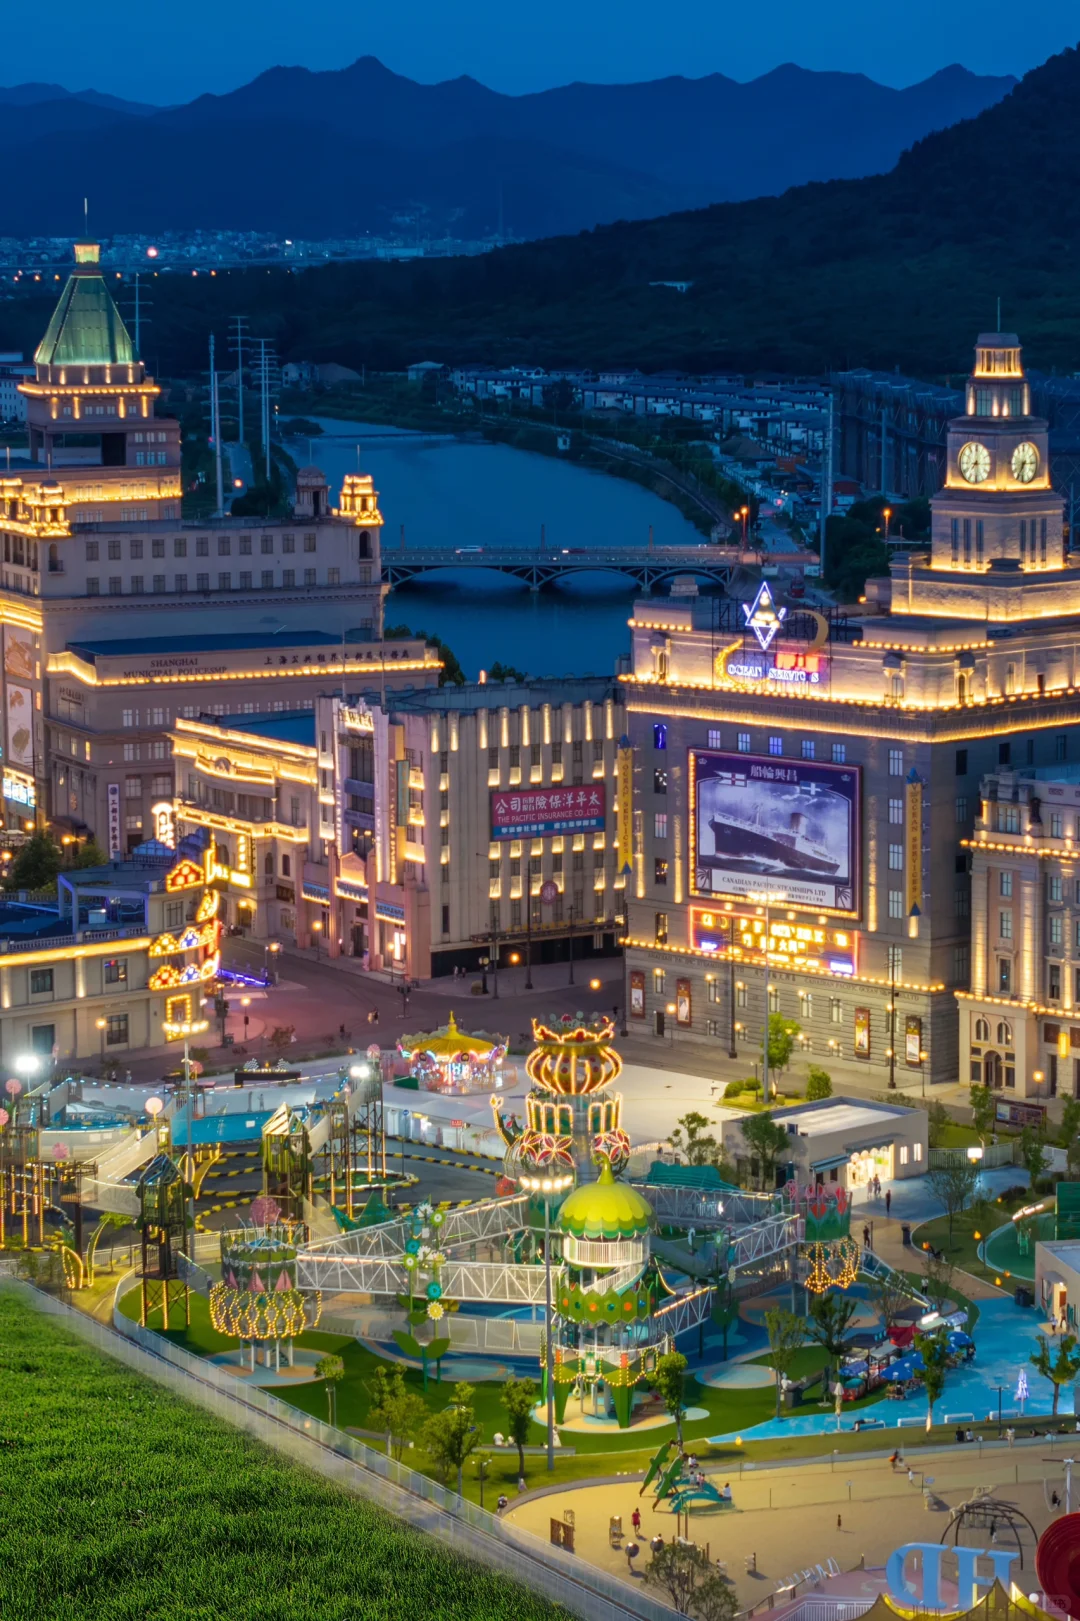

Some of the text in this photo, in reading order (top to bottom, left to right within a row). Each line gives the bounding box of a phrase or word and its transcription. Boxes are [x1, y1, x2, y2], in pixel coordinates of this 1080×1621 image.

[150, 657, 199, 668] SHANGHAI
[123, 668, 174, 679] MUNICIPAL
[497, 816, 510, 824] THE
[511, 813, 536, 823] PACIFIC
[537, 810, 572, 821] INSURANCE
[722, 876, 827, 897] CANADIAN PACIFIC STEAMSHIPS LTD
